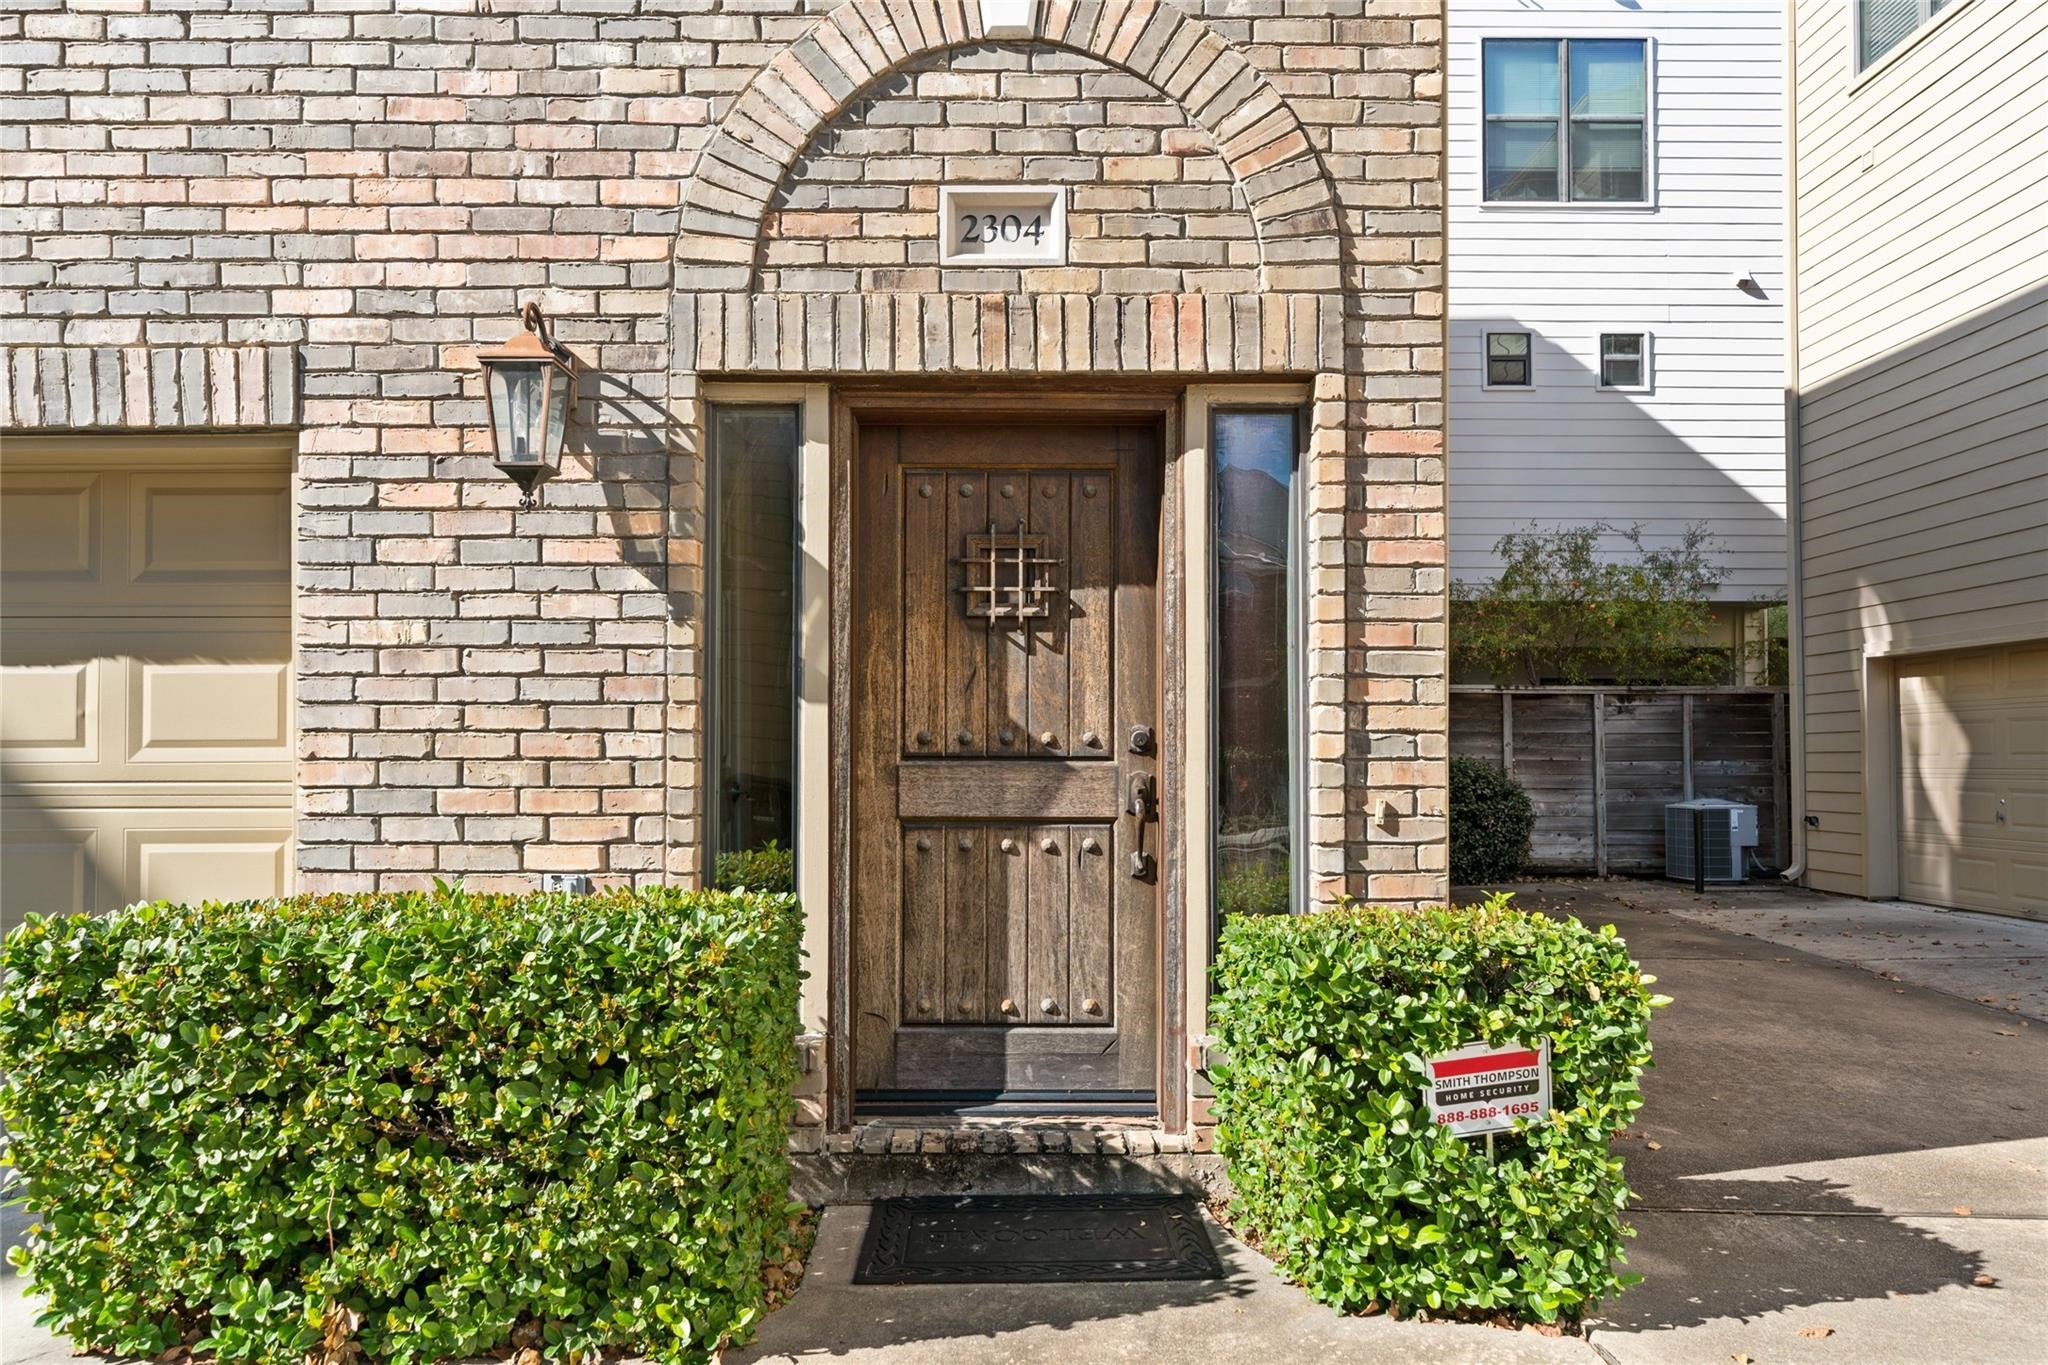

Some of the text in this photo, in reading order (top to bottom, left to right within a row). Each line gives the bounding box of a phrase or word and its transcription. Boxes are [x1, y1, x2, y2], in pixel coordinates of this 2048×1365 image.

[960, 214, 1044, 246] 2304
[1435, 1067, 1539, 1090] SMITH THOMPSON
[1445, 1085, 1530, 1102] HOME SECURITY
[1437, 1101, 1539, 1125] 888-888-1695
[929, 1227, 1146, 1243] WELCOME
